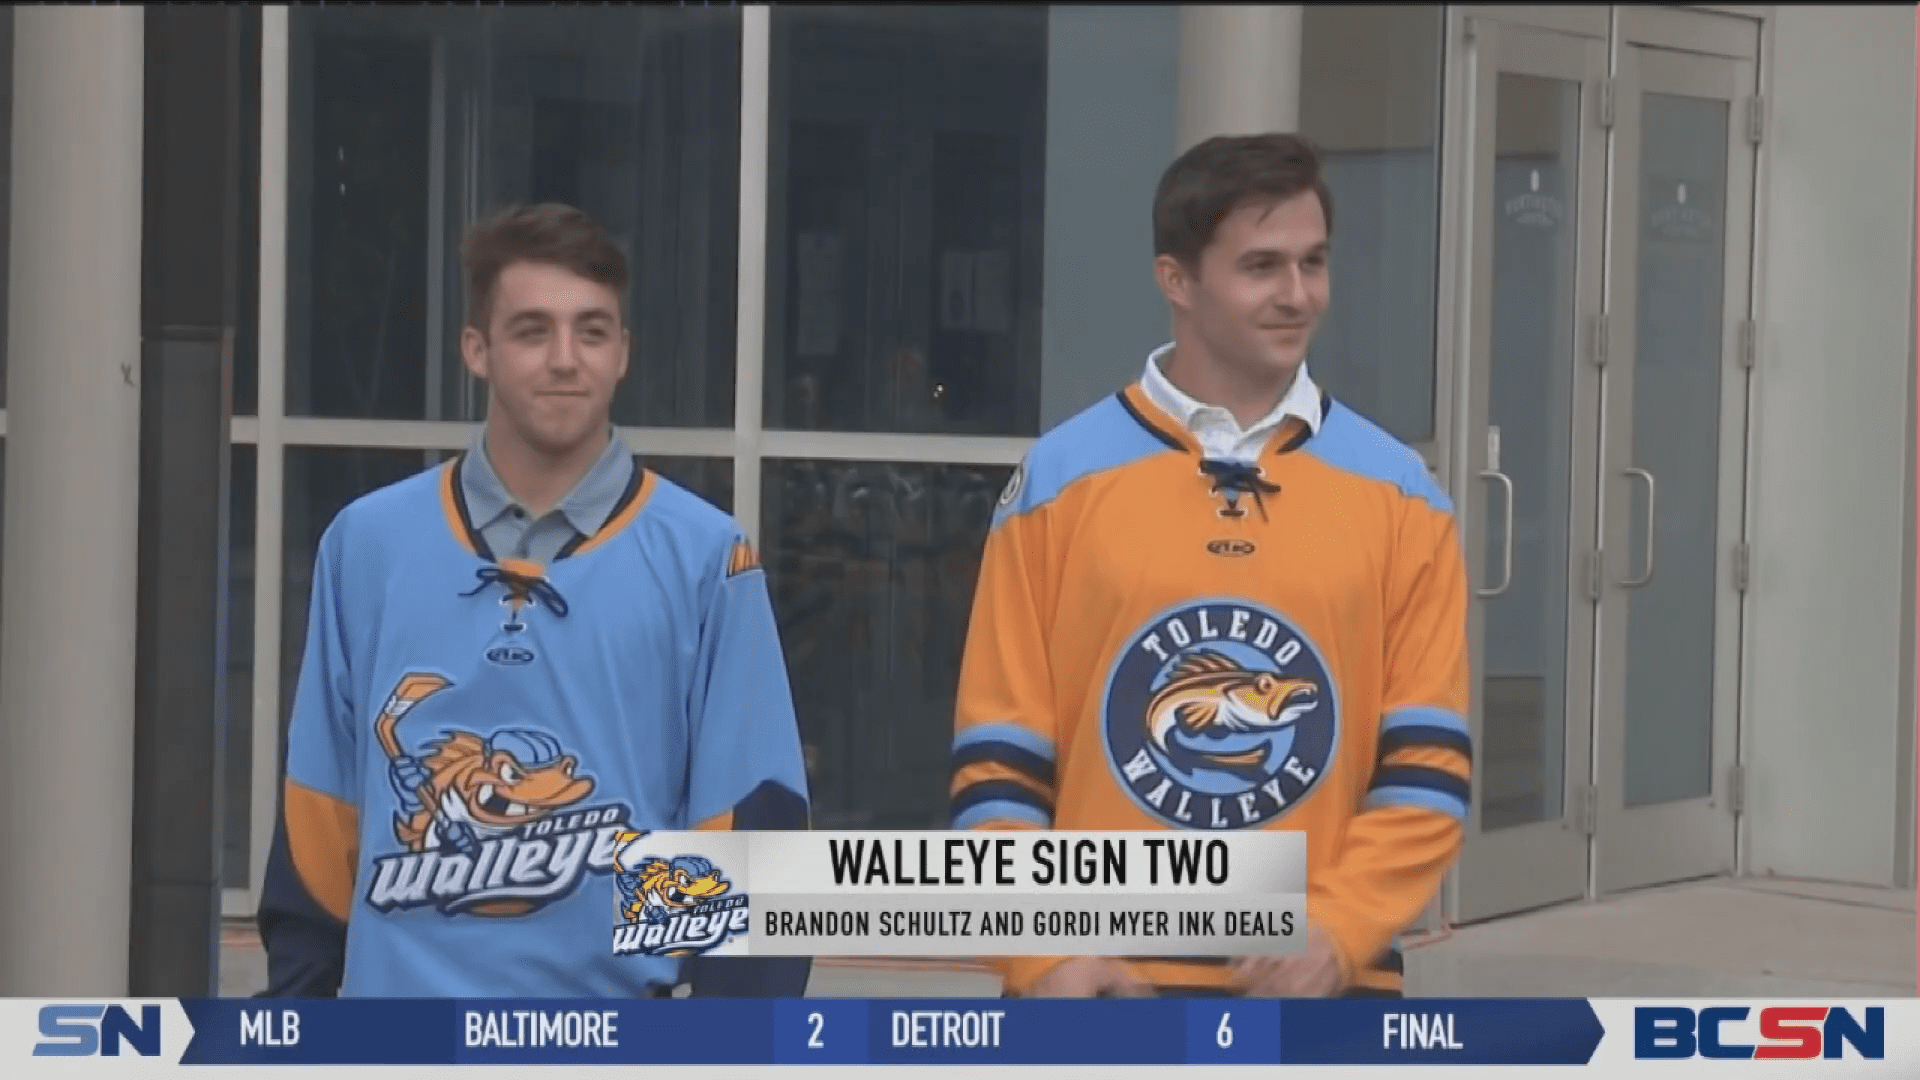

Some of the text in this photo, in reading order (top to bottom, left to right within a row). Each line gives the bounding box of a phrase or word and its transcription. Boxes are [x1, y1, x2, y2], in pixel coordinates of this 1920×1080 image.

[1142, 608, 1302, 666] TOLEDO
[1122, 749, 1316, 828] WALLEYE
[522, 807, 620, 838] TOLEDO
